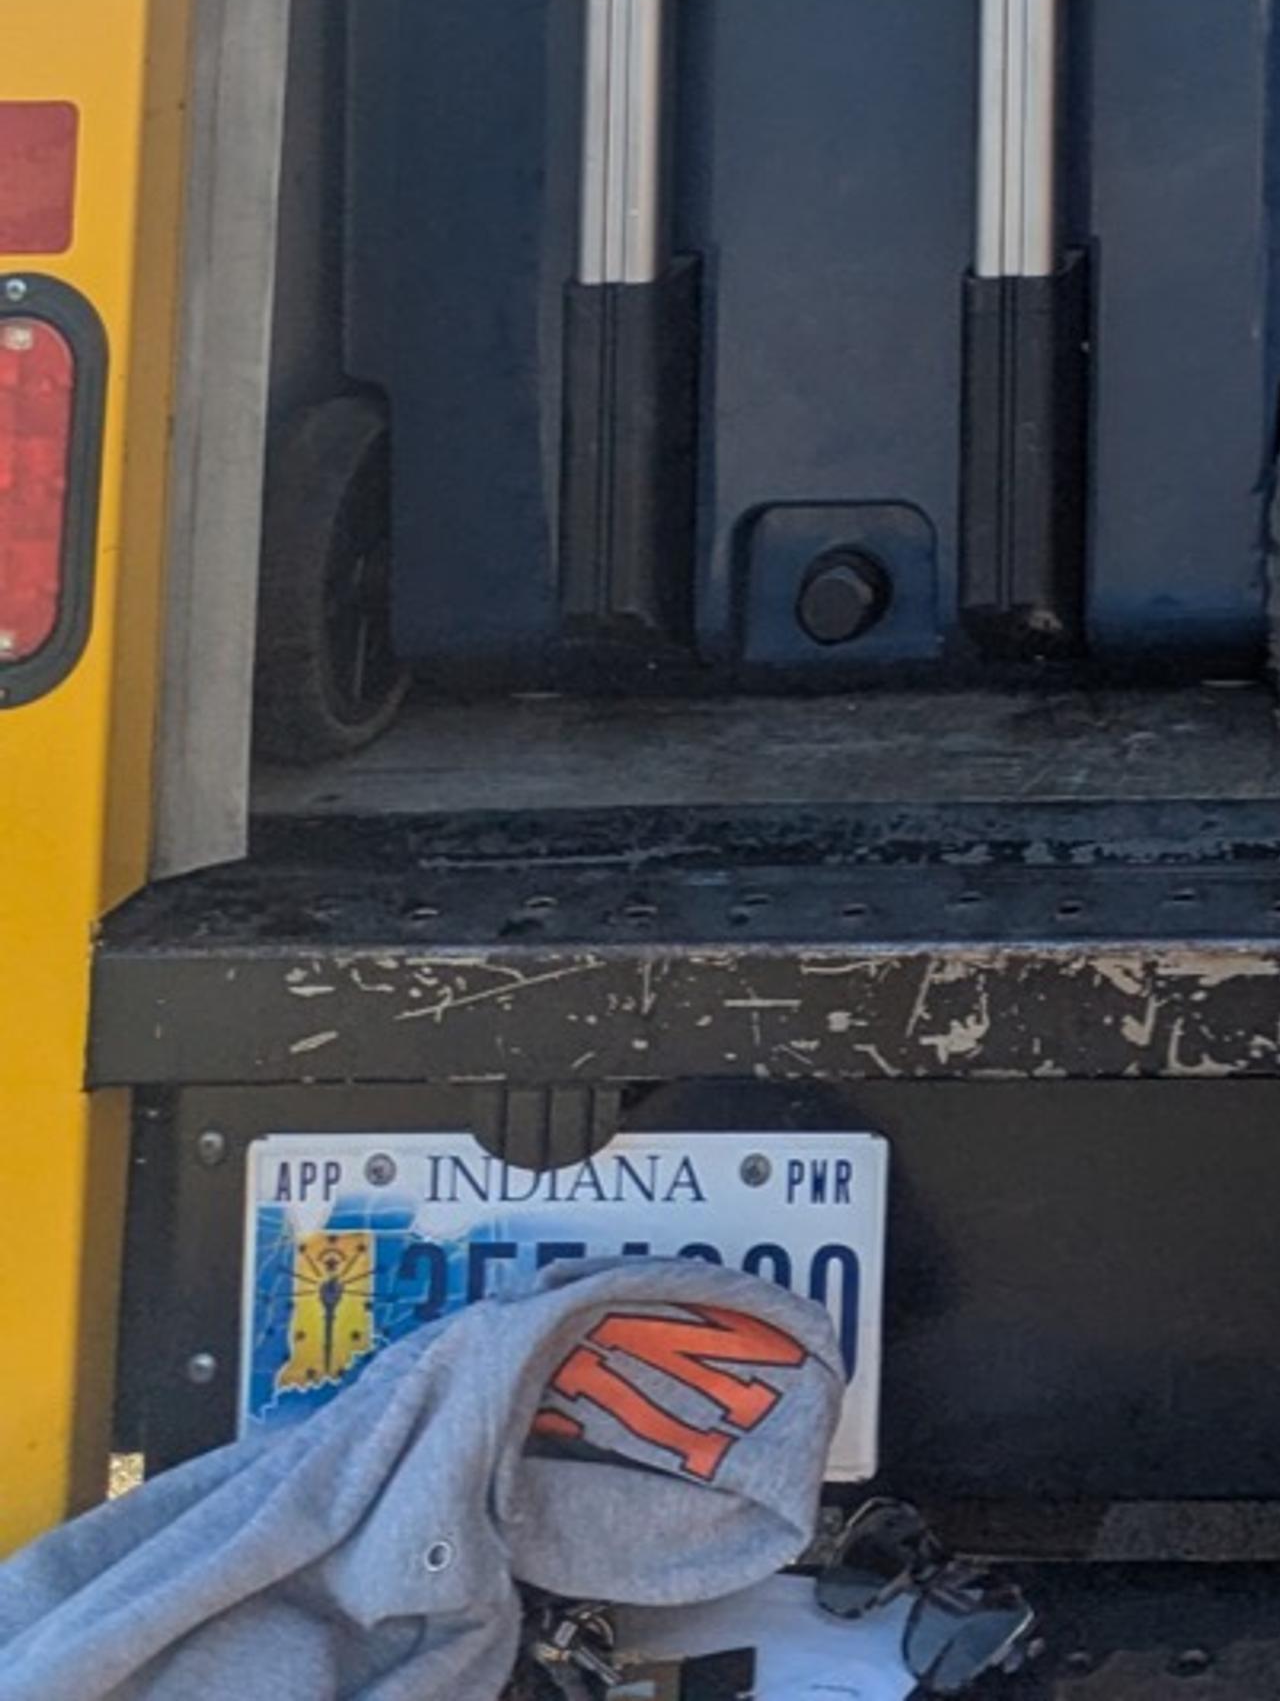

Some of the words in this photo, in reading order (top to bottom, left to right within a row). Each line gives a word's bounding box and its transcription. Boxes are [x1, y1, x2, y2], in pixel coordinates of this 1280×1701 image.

[274, 1160, 342, 1203] APP
[425, 1154, 706, 1203] INDIANA
[786, 1158, 853, 1205] PWR
